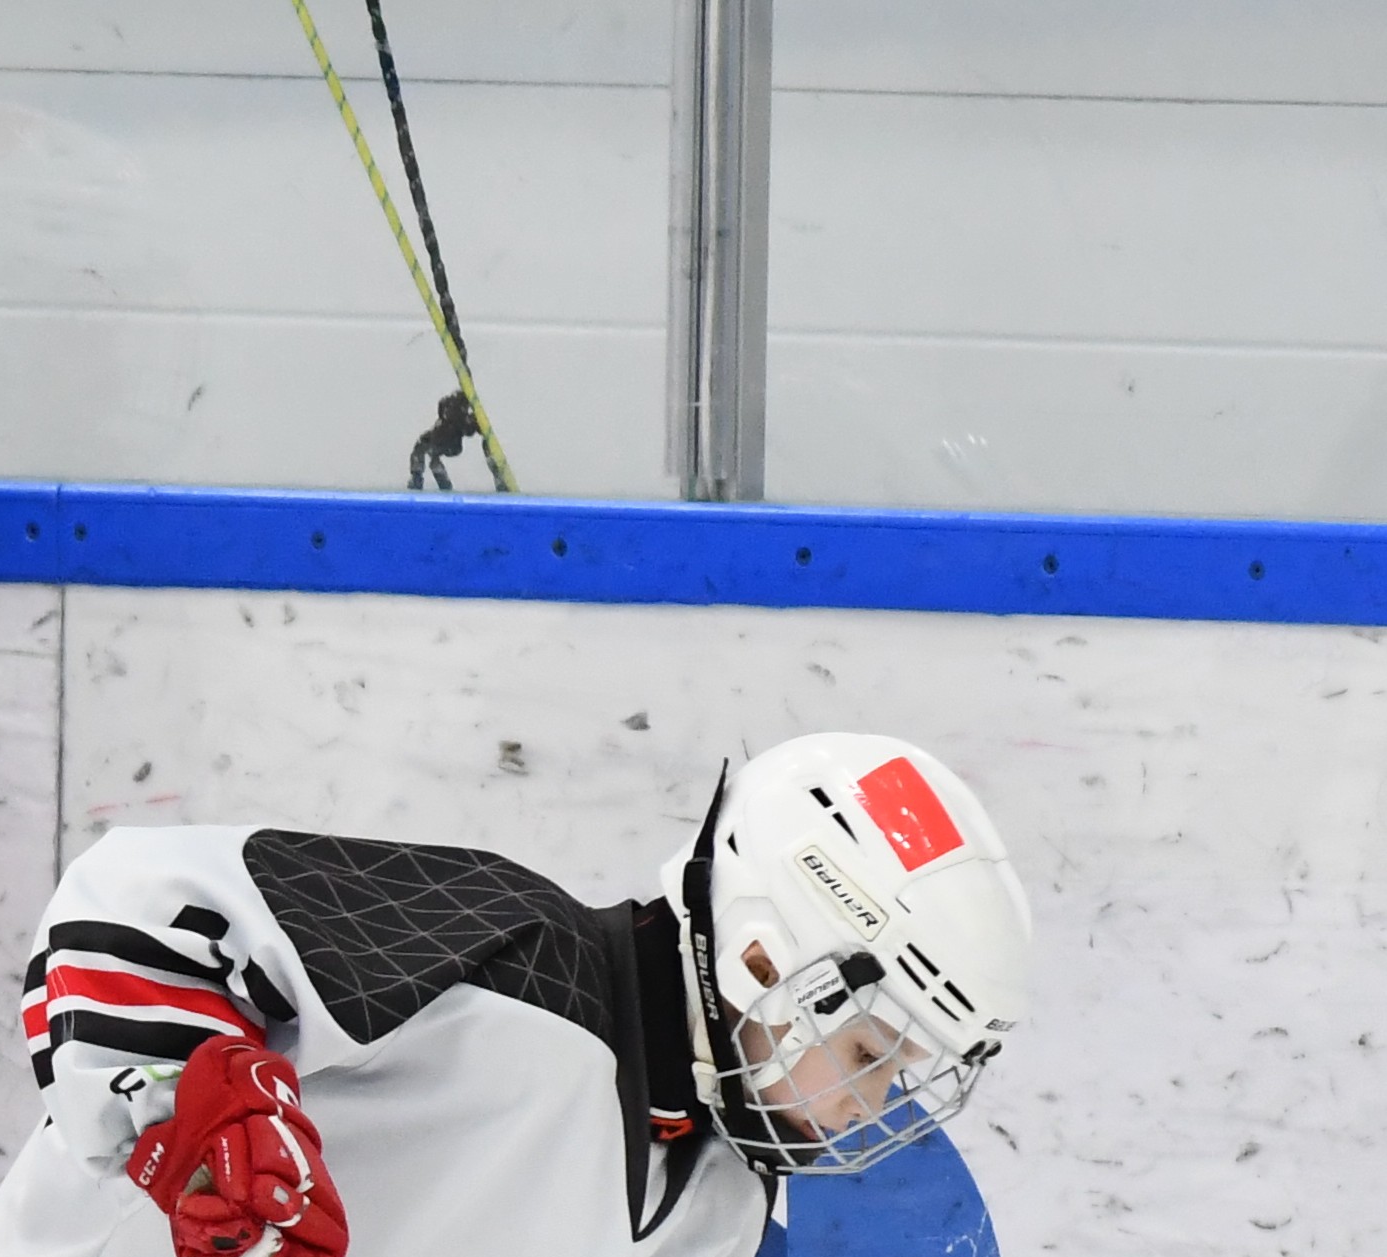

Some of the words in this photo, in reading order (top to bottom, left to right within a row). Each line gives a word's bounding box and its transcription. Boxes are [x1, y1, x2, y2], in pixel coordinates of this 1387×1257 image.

[802, 854, 879, 928] BAUER
[694, 932, 720, 1021] BAUER
[138, 1142, 165, 1187] CCM
